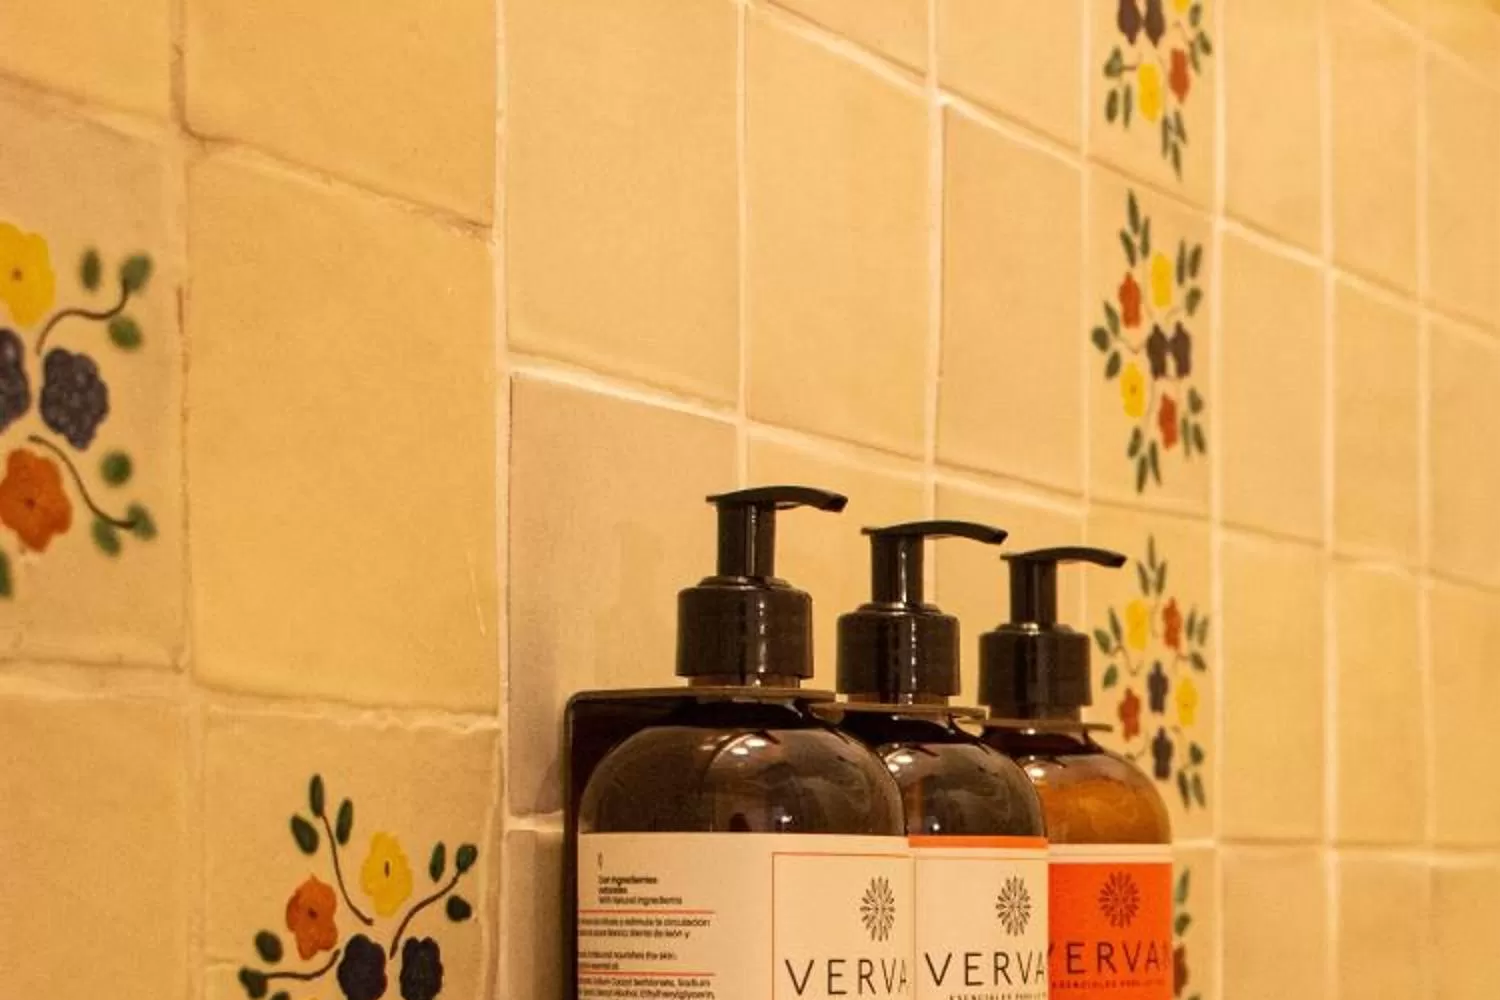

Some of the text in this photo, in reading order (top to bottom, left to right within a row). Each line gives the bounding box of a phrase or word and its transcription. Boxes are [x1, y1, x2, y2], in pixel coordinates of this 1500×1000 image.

[924, 950, 1045, 987] VERVA
[1047, 940, 1169, 976] ERVA
[784, 957, 907, 997] VERVA
